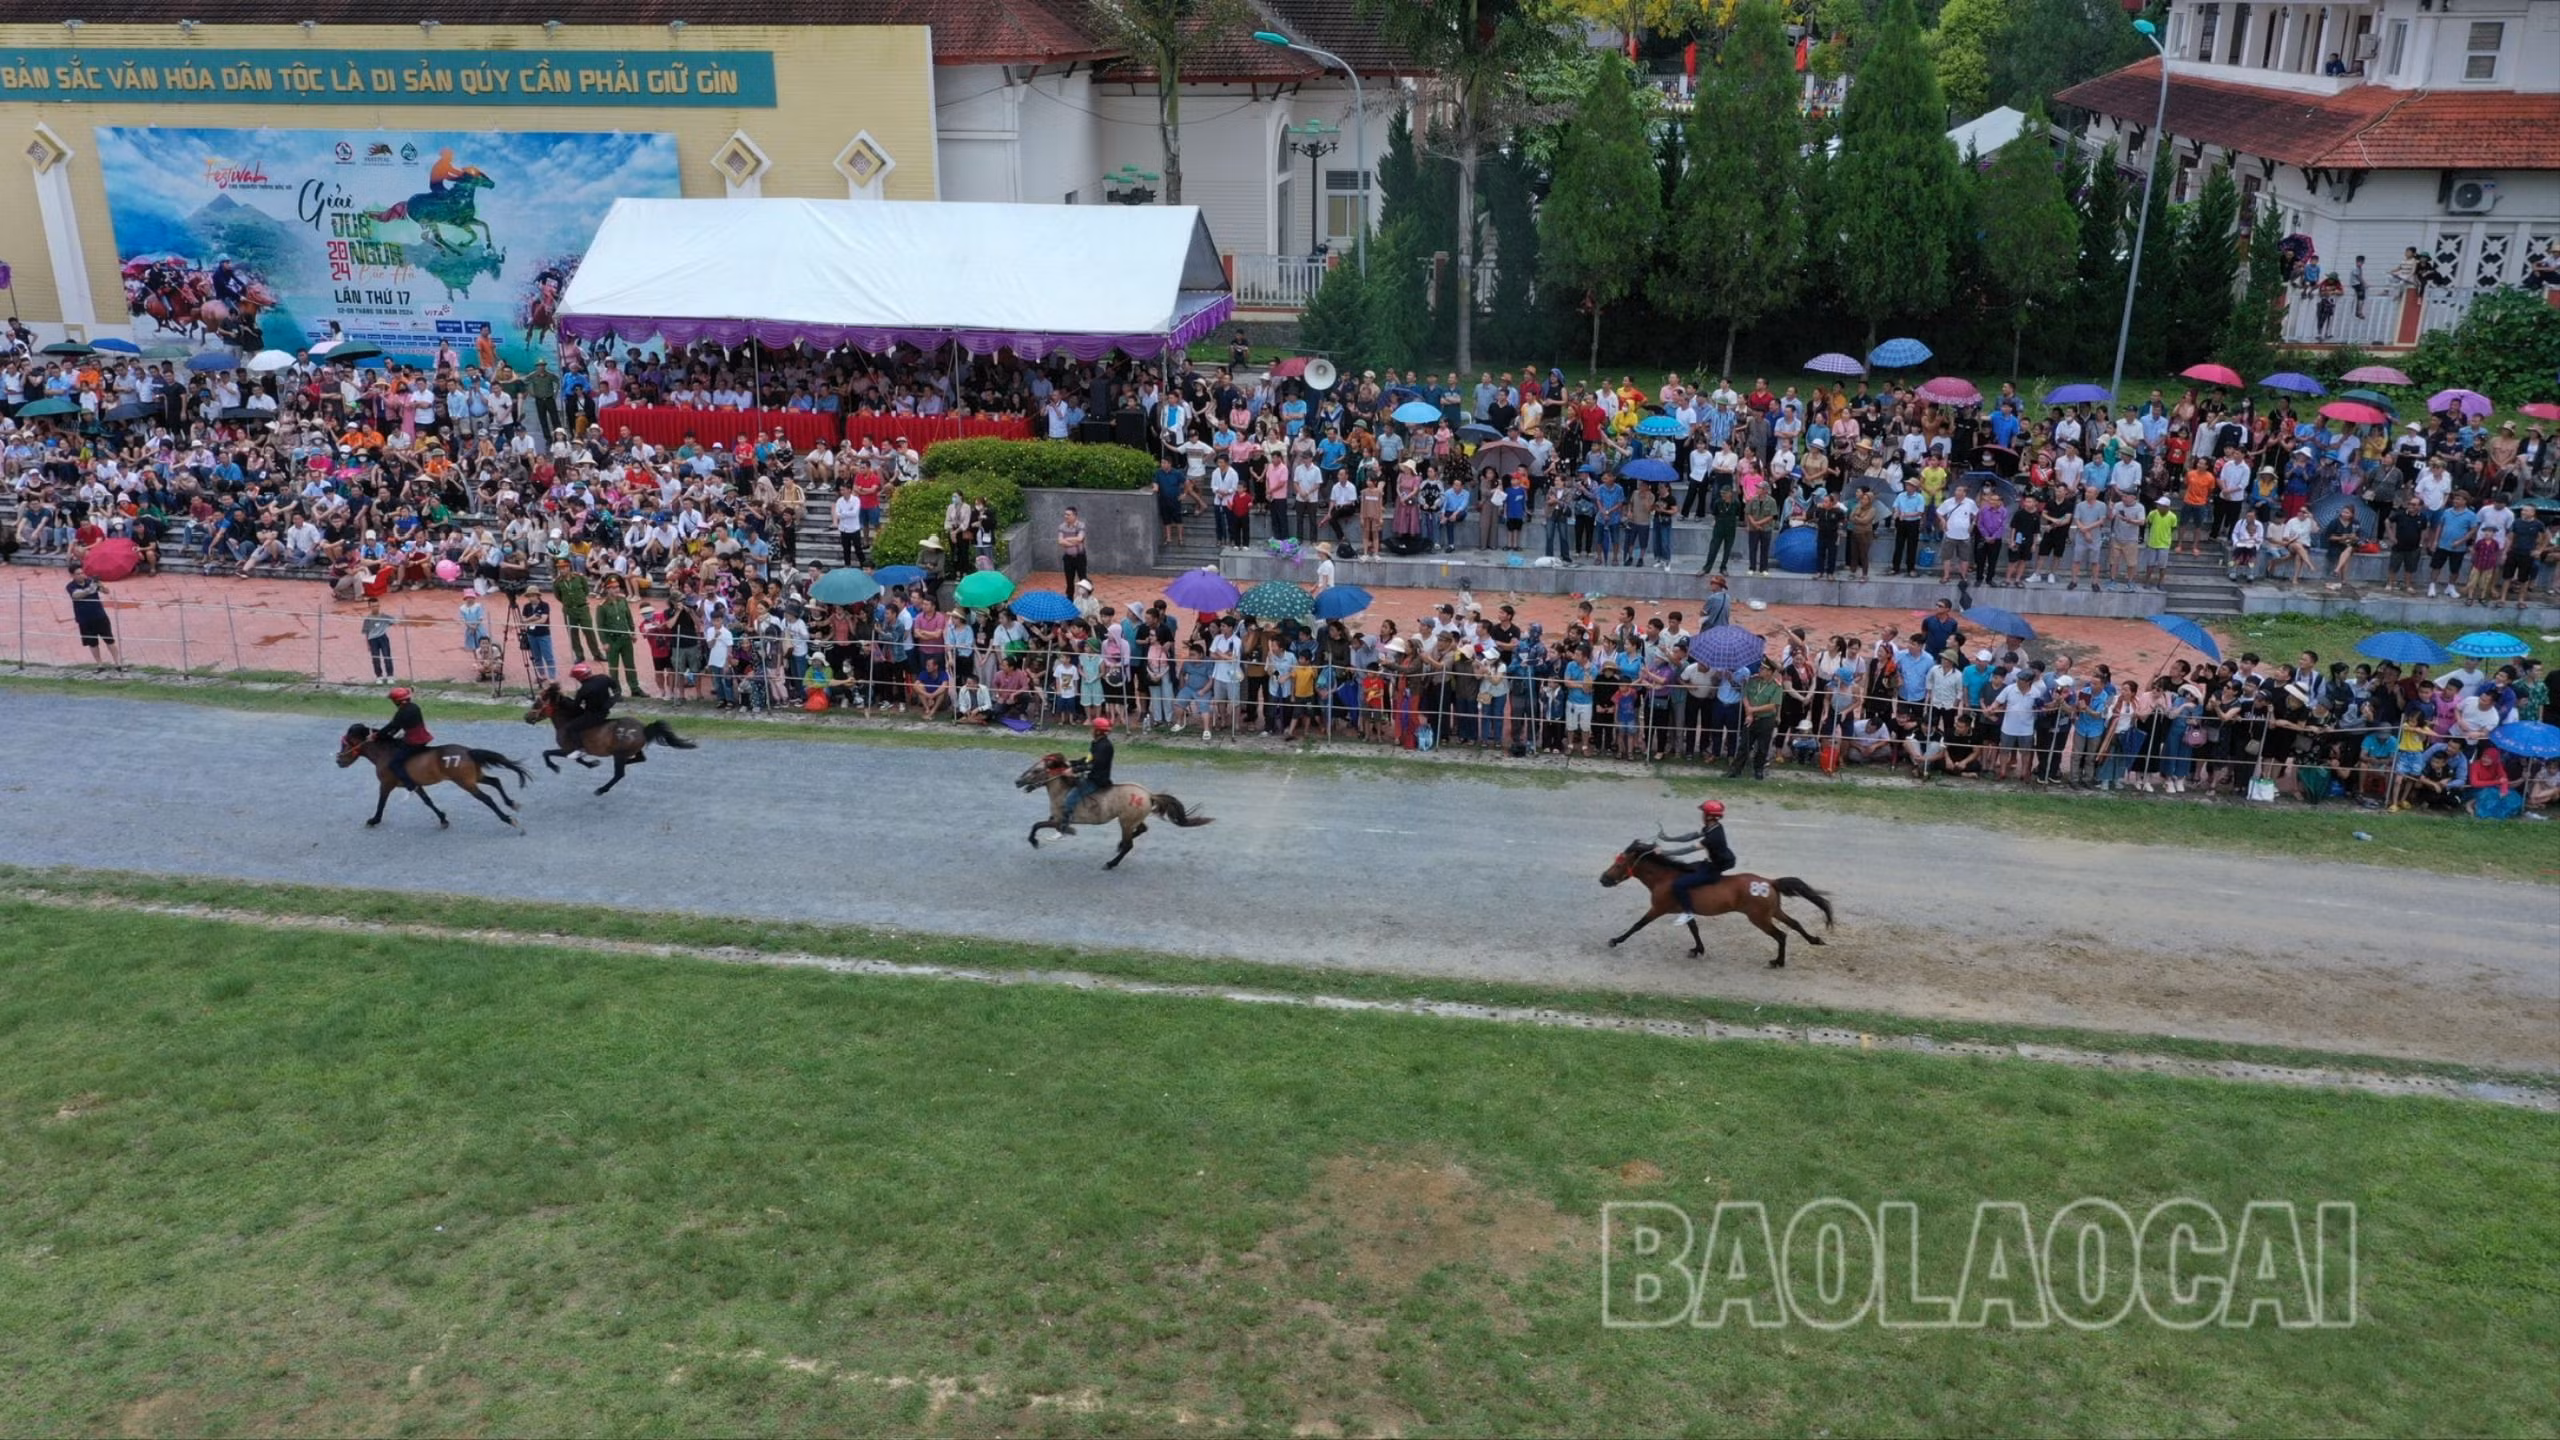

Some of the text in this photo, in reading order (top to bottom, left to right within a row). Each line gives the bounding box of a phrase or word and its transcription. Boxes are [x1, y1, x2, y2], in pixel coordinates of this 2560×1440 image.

[1, 54, 738, 97] BẢN SẮC VĂN HÓA DÂN TỘC LÀ DI SẢN QÚY CẦN PHẢI GIỮ GÌN
[298, 178, 354, 232] Giải
[327, 241, 348, 260] 20
[330, 262, 351, 280] 24
[335, 286, 410, 305] LẦN THỨ 17
[441, 755, 461, 769] 77
[1749, 881, 1771, 898] 86
